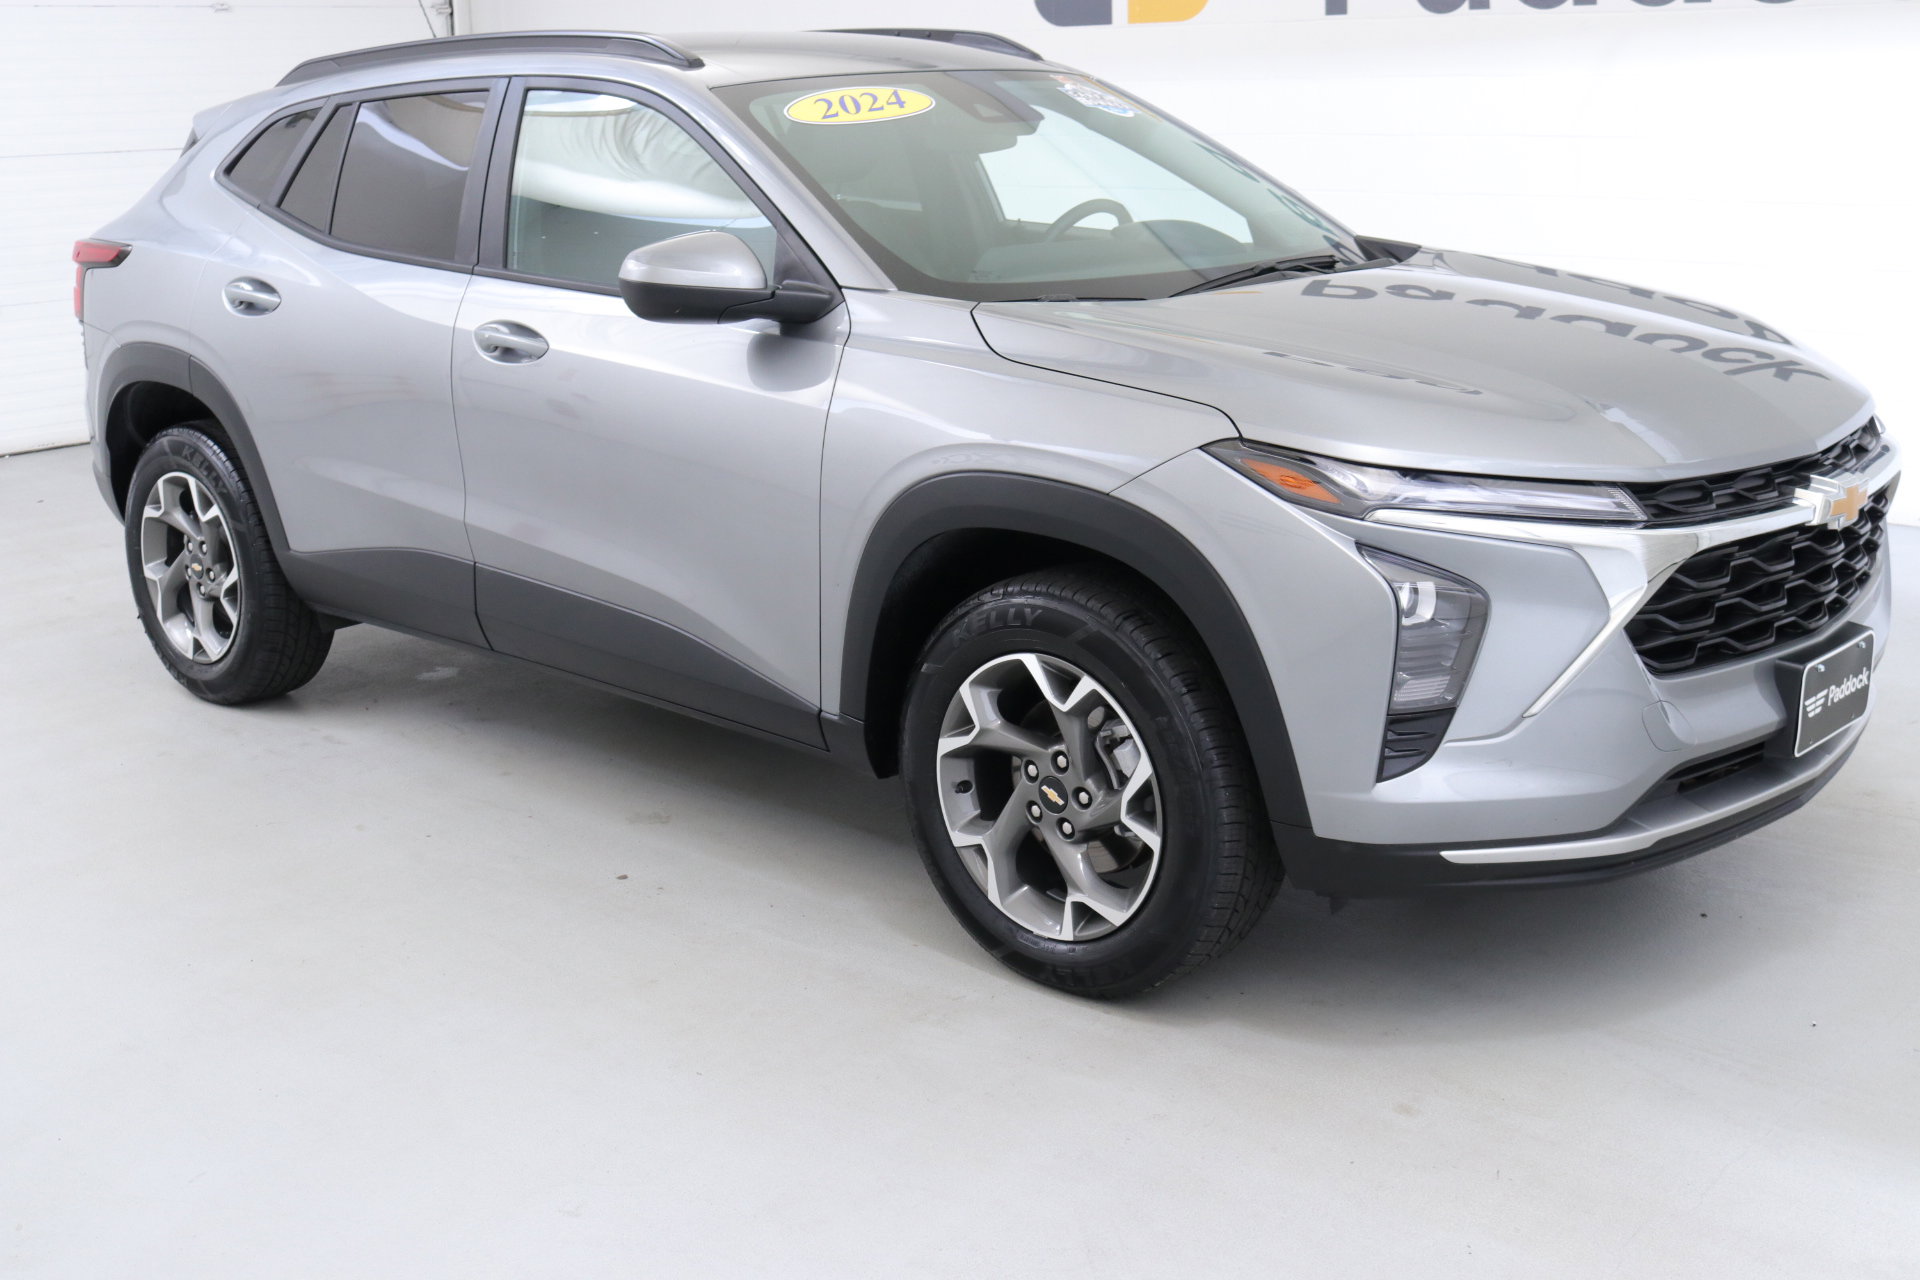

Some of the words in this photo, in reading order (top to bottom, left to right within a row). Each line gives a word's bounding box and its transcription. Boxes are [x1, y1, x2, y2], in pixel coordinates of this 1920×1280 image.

[813, 89, 906, 120] 2024
[951, 607, 1043, 648] KELLY
[1827, 667, 1870, 707] Paddock
